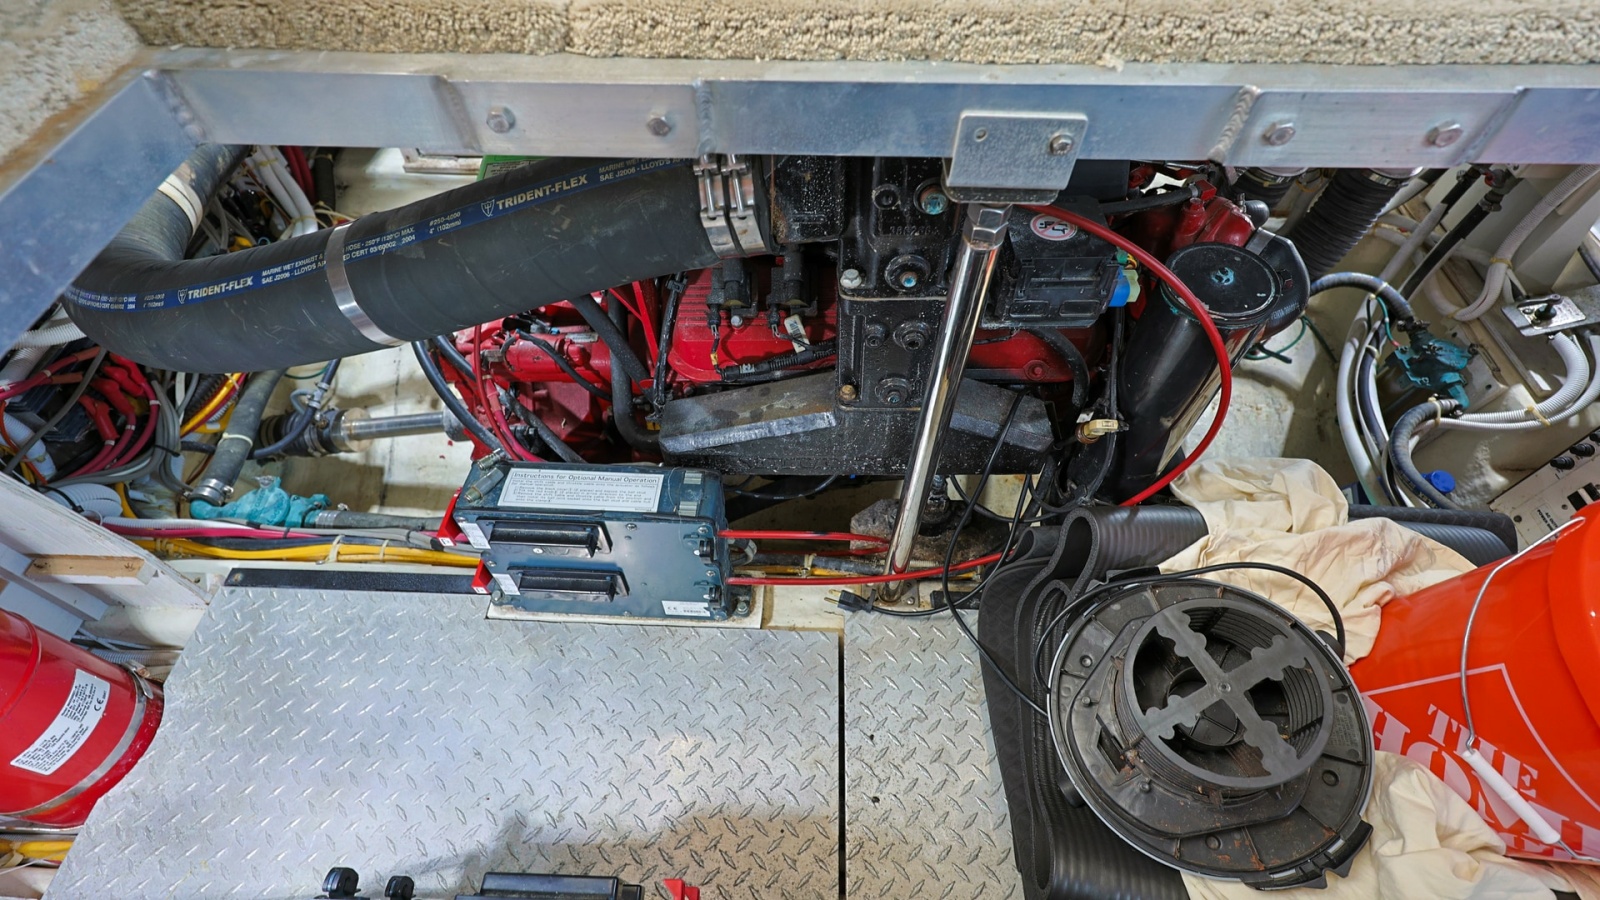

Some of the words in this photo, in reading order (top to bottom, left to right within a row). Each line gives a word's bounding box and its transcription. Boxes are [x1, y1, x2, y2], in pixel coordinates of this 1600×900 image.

[599, 161, 625, 173] MARINE
[600, 173, 614, 181] SAE
[496, 174, 588, 210] TRIDENT-FLEX
[351, 248, 368, 258] CERT
[261, 276, 273, 284] SAE
[187, 275, 254, 300] TRIDENT-FLEX
[1427, 703, 1538, 798] THE
